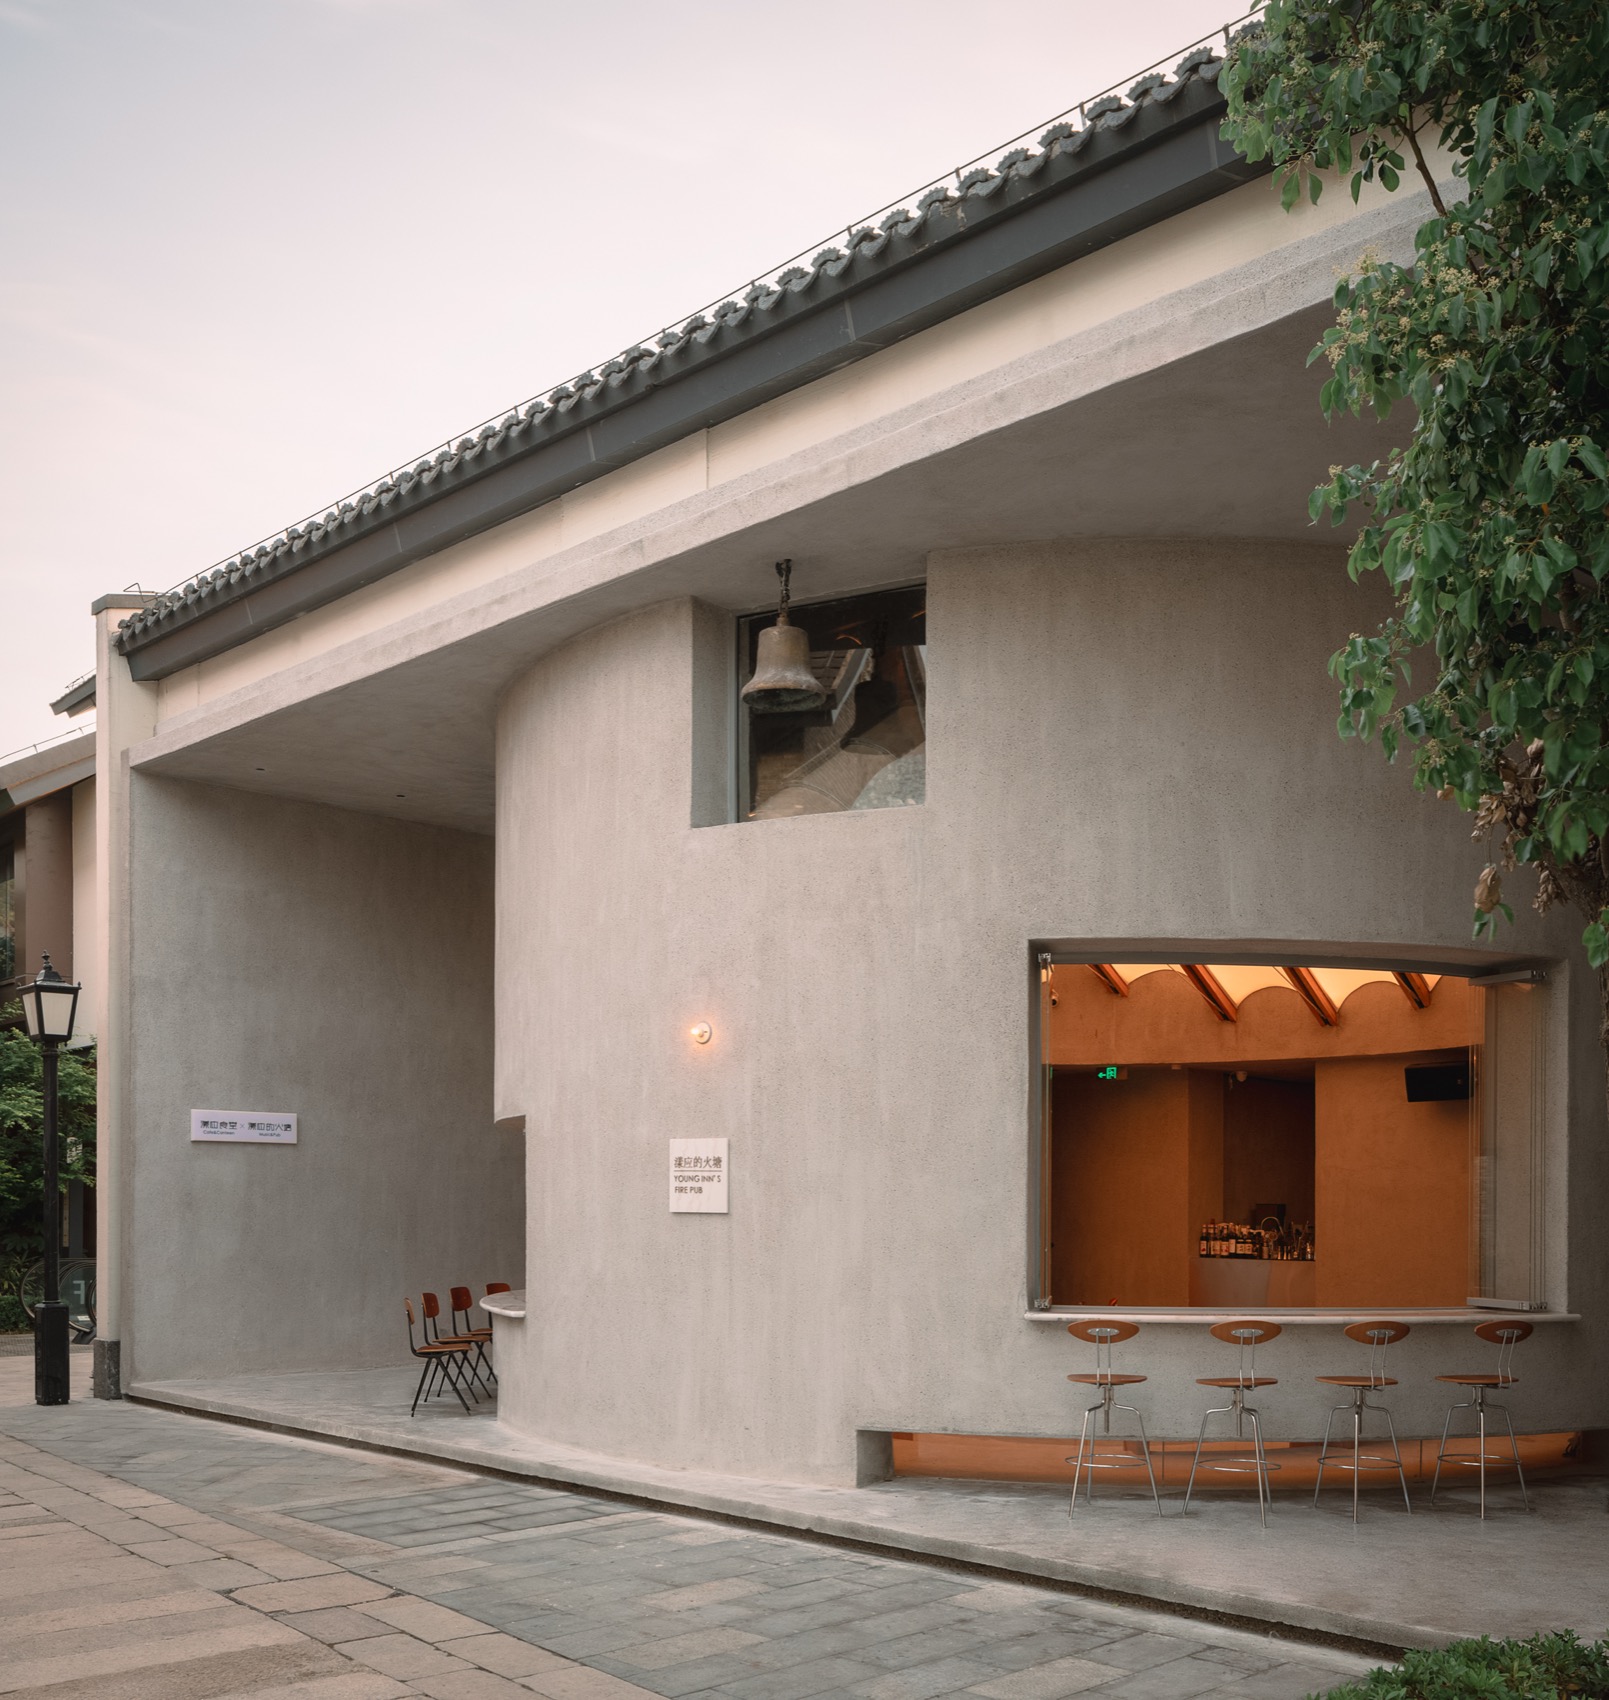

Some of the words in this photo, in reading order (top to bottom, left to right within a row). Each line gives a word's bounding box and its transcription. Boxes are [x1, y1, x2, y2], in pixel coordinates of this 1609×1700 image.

[674, 1175, 700, 1183] YOUNG
[674, 1186, 688, 1194] FIRE
[689, 1186, 703, 1194] PUB
